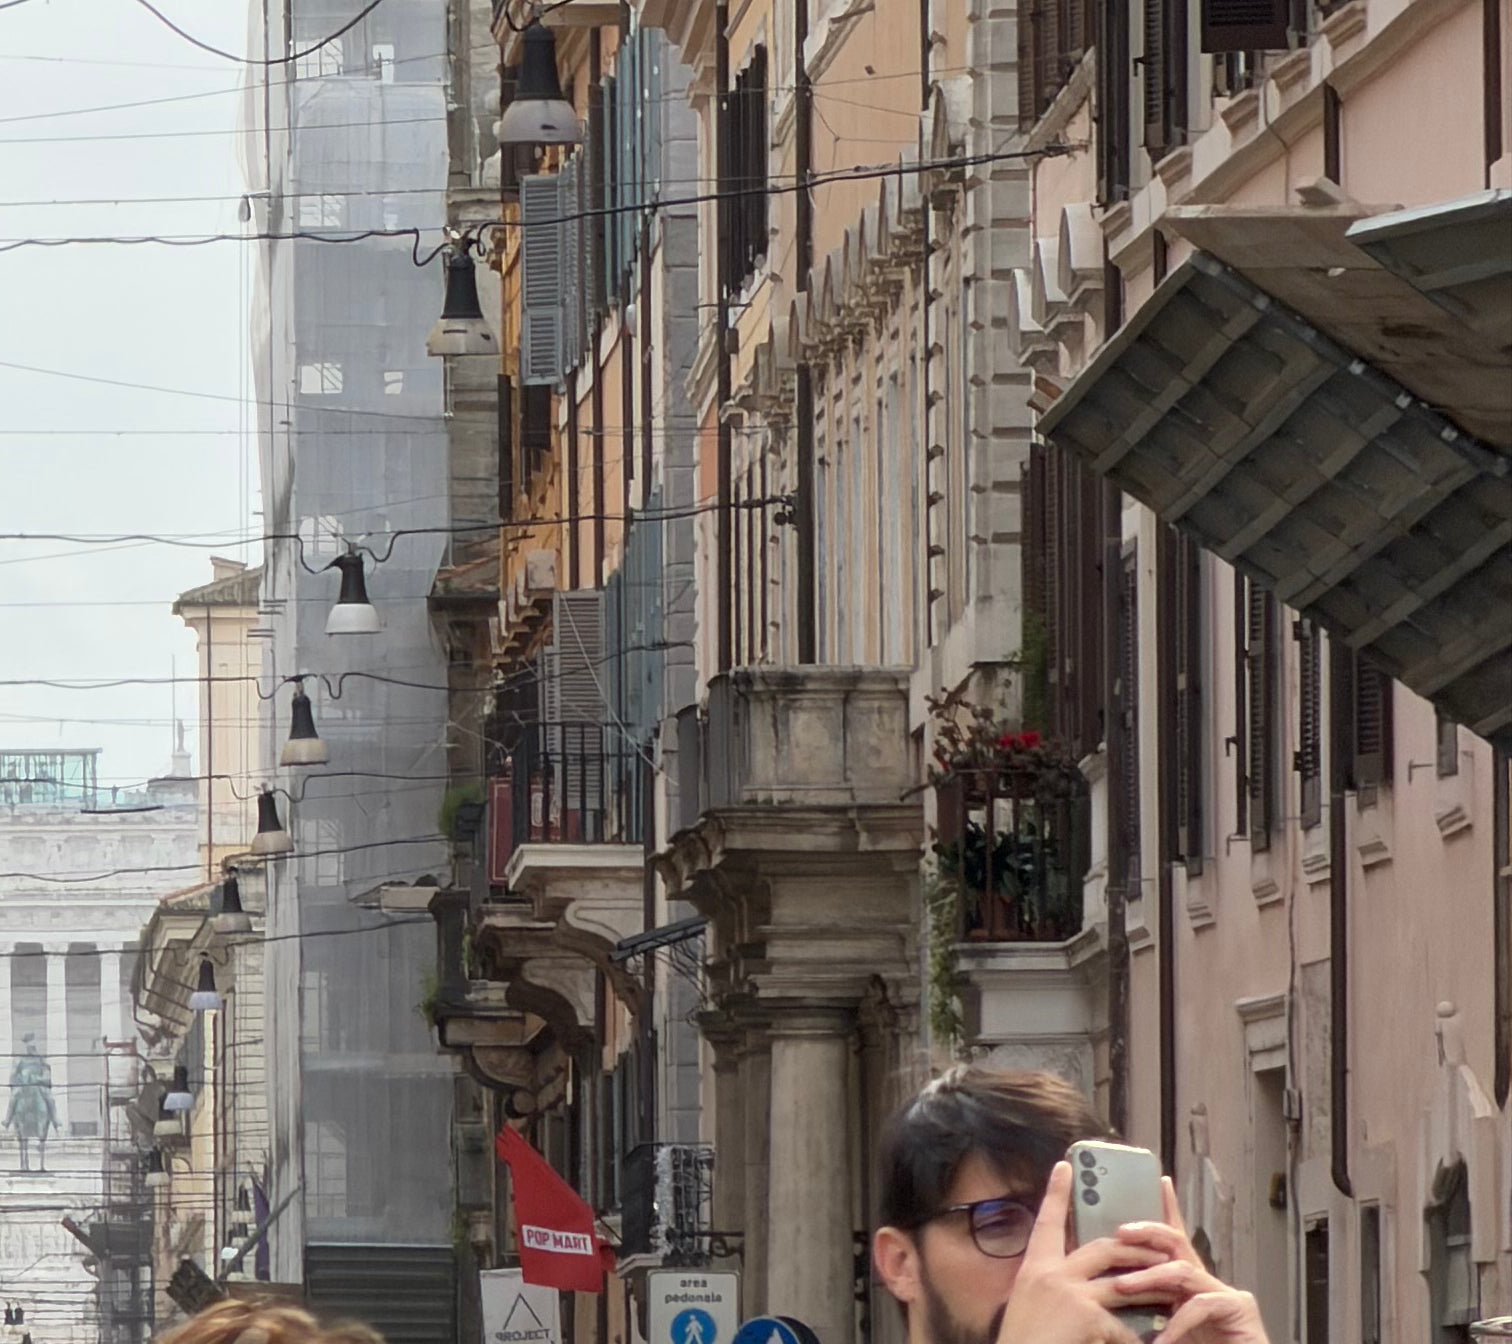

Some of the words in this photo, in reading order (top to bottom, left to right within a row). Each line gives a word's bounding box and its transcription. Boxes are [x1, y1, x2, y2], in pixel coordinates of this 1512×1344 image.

[526, 1229, 550, 1245] POP
[552, 1233, 588, 1251] MART
[680, 1278, 708, 1288] area
[664, 1292, 723, 1304] pedonale
